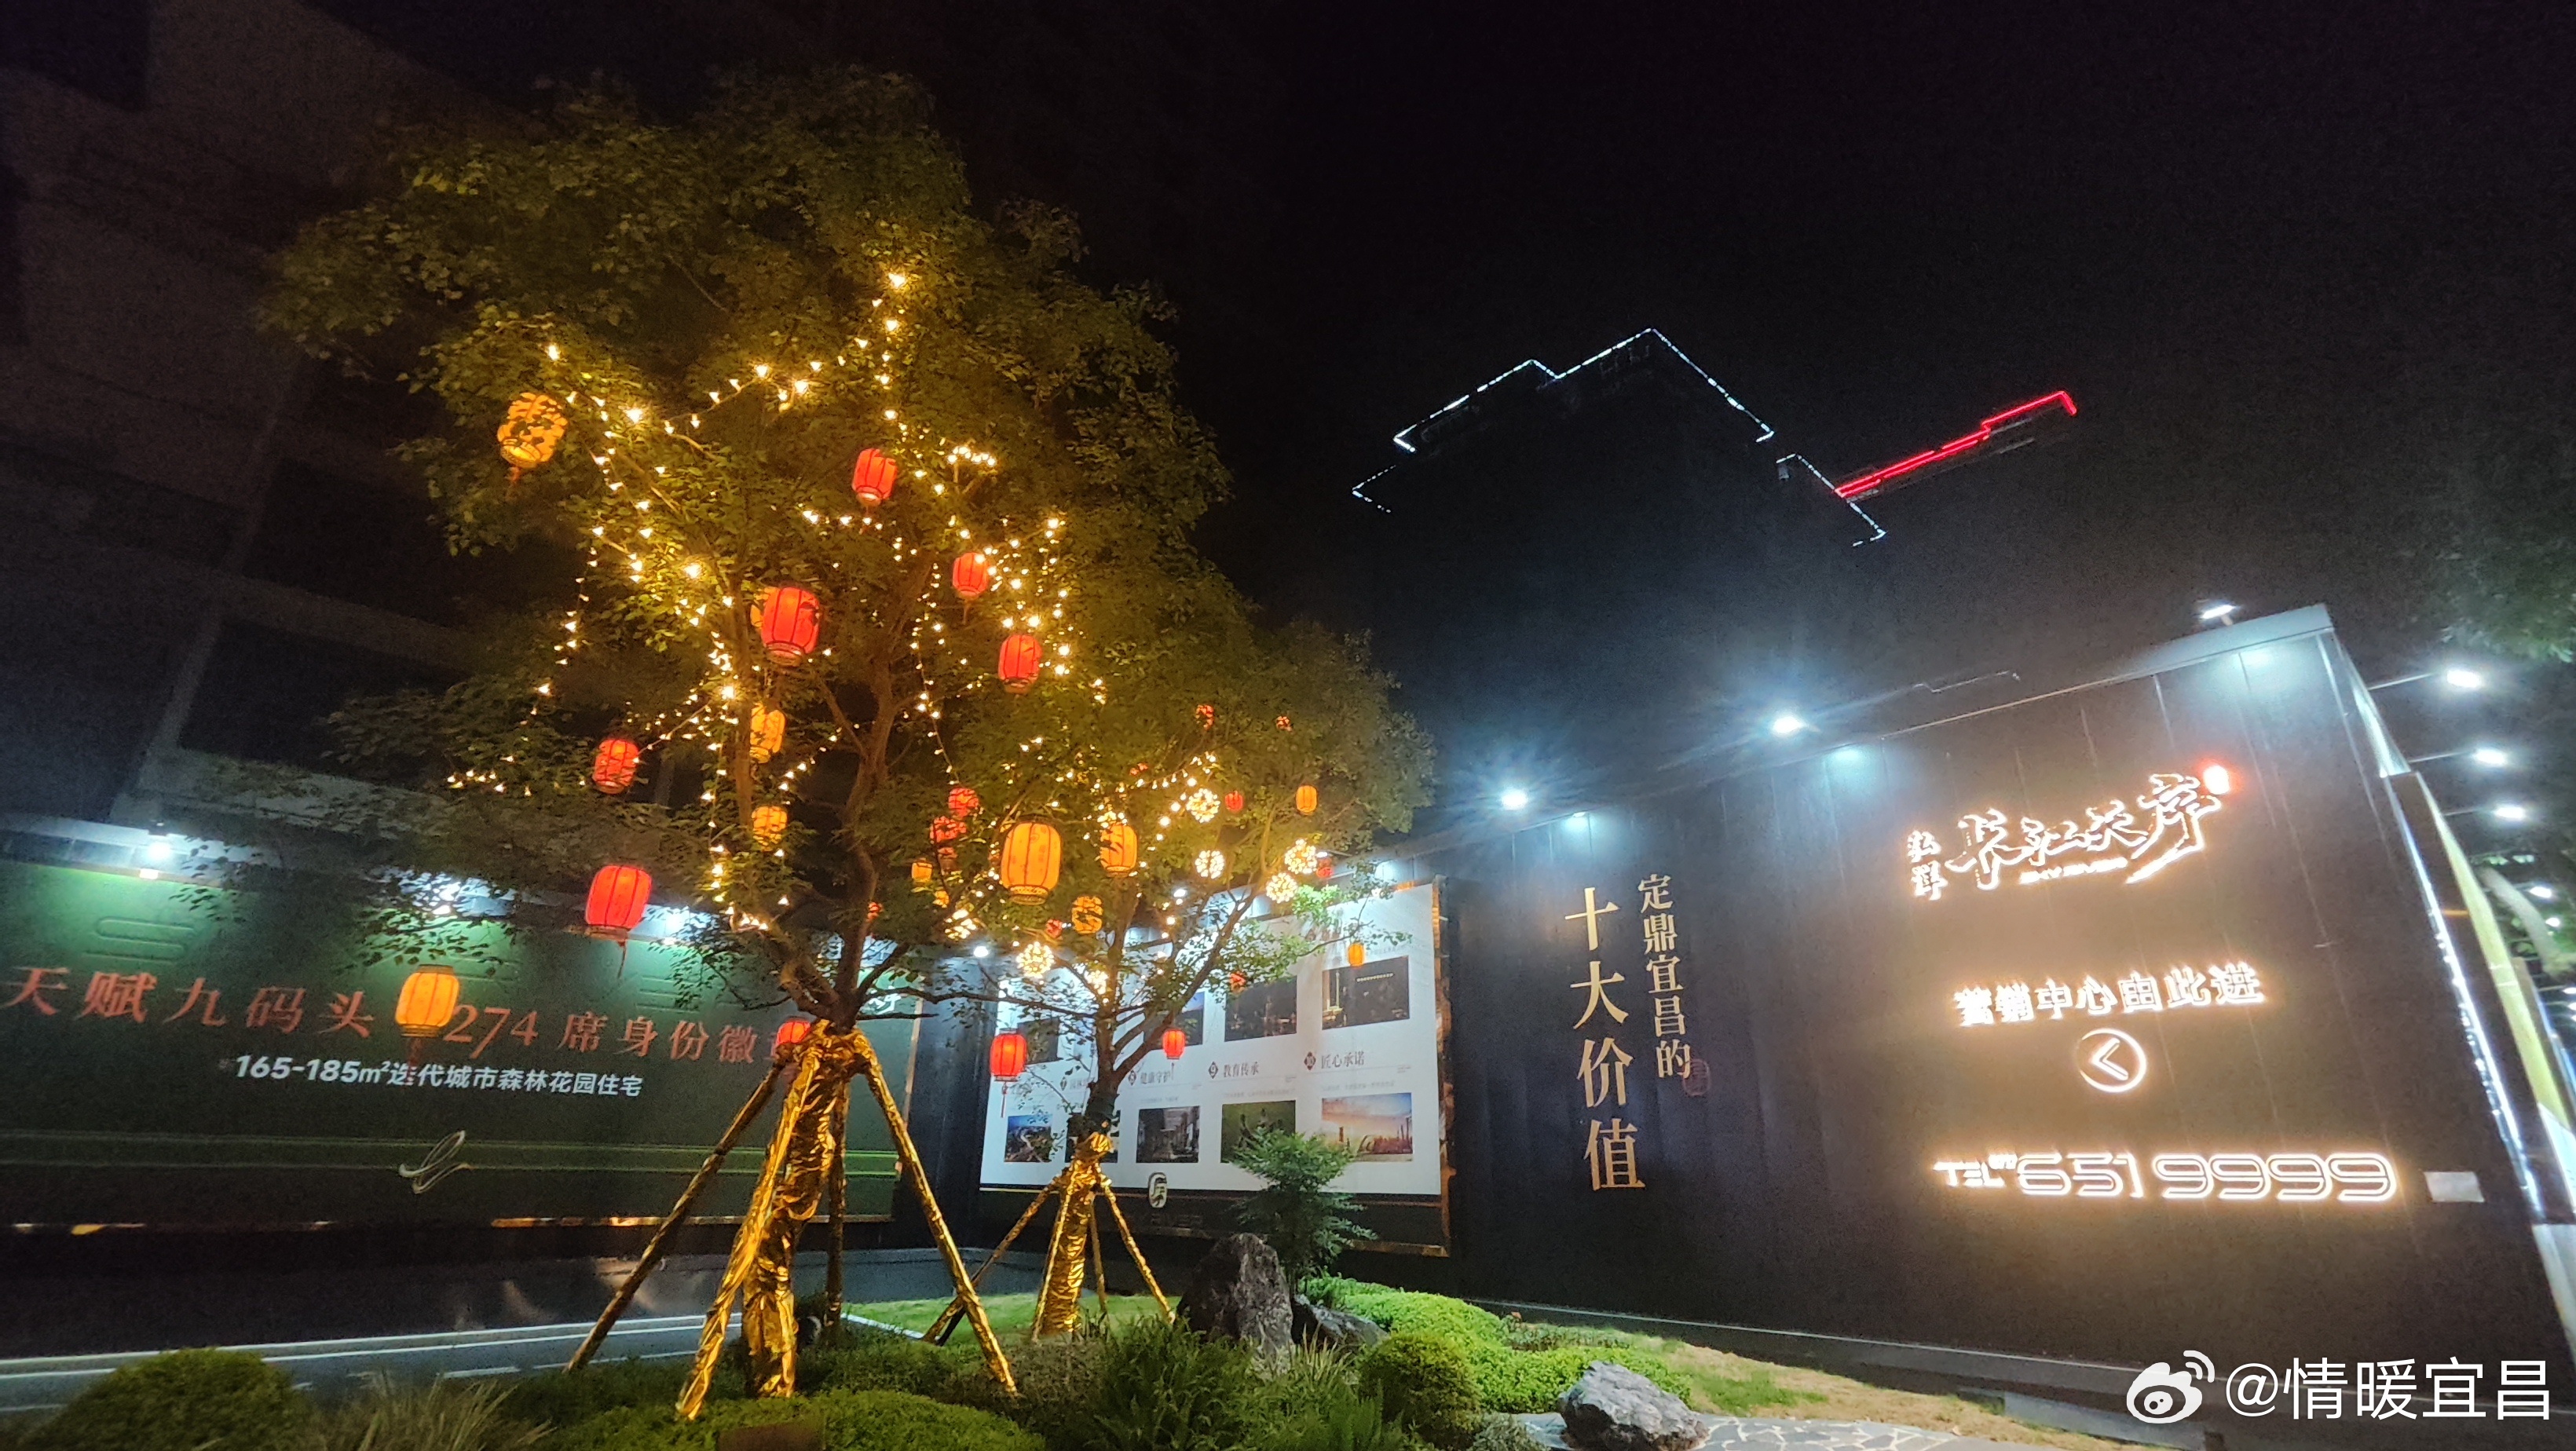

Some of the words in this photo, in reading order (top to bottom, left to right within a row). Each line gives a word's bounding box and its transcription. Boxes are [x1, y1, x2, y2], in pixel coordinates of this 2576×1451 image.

[1637, 873, 1692, 1079] 定鼎宜昌的
[441, 1003, 789, 1065] 274席身份徽
[1564, 886, 1646, 1191] 十大价值
[1224, 1061, 1260, 1078] 教育传承
[1321, 1051, 1365, 1069] 匠心承诺
[1934, 1160, 2005, 1187] TEL
